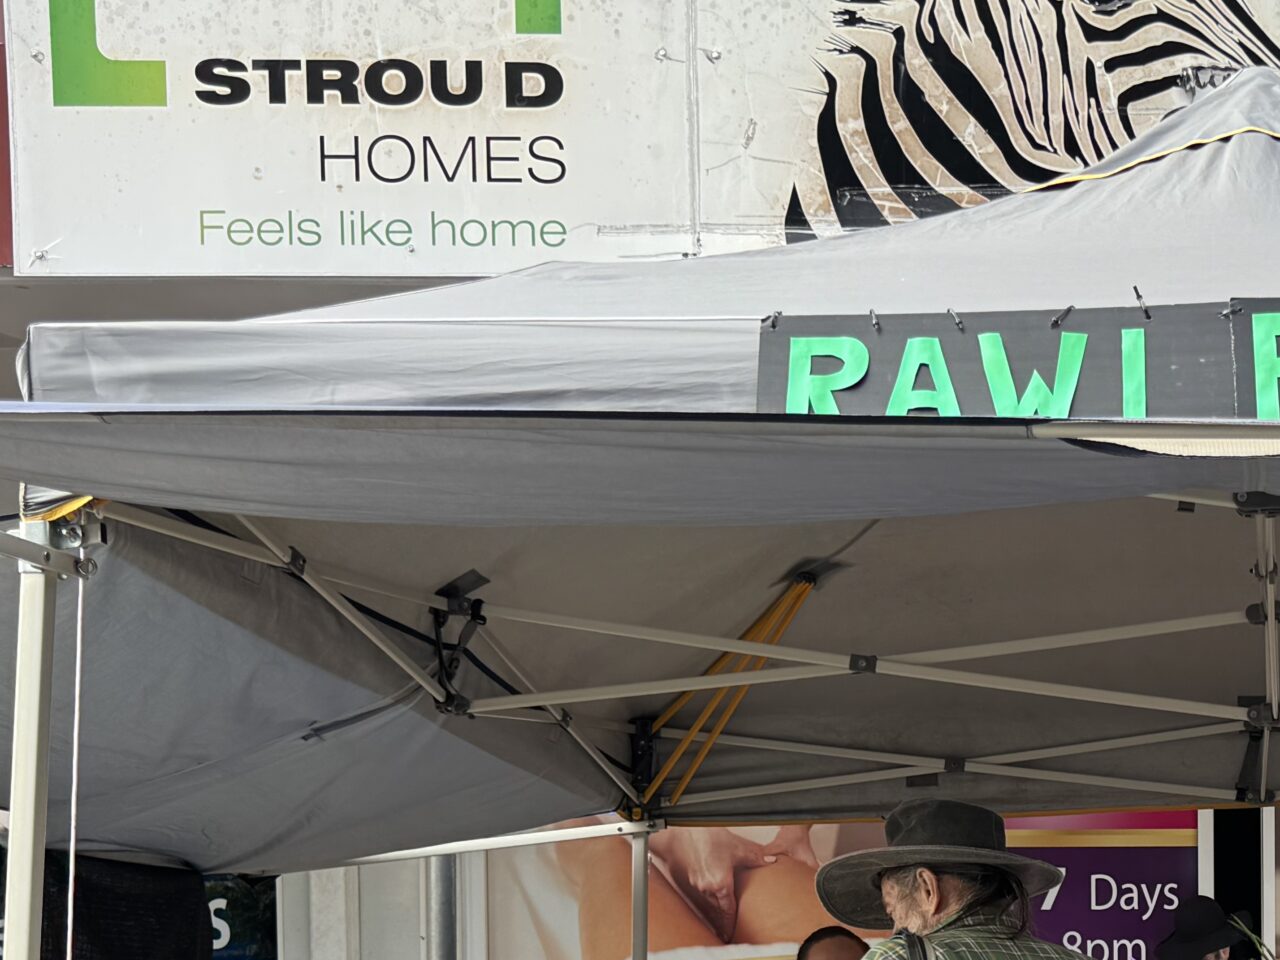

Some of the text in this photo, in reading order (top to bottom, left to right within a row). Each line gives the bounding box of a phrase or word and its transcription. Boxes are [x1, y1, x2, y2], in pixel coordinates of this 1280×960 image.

[194, 58, 564, 108] STROUD
[319, 135, 567, 184] HOMES
[199, 210, 567, 247] Feels like home
[1090, 873, 1179, 921] Days
